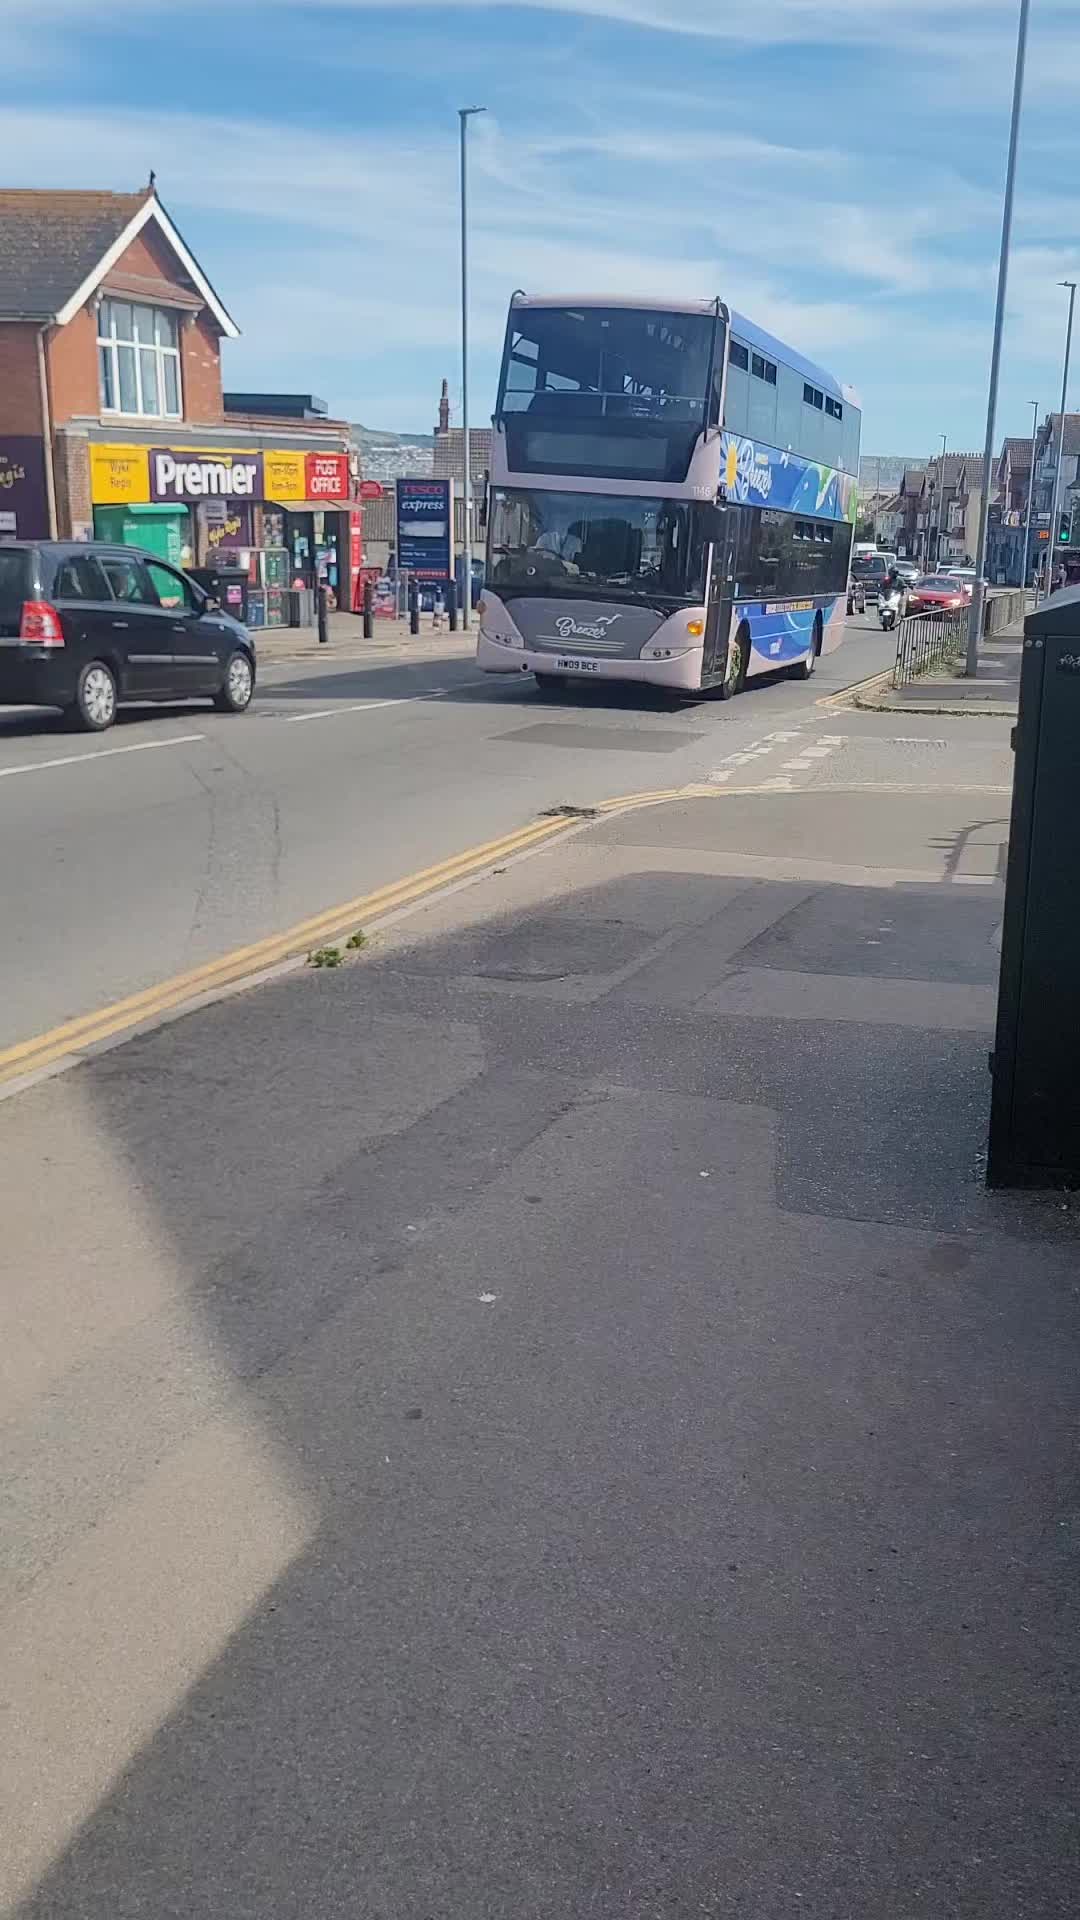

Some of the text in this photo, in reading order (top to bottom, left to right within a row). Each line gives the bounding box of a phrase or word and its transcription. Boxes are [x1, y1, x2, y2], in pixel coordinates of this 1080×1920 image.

[155, 454, 257, 496] Premier
[315, 459, 338, 476] POST
[738, 440, 773, 501] Breezer
[311, 477, 341, 493] OFFICE
[404, 485, 444, 495] TESCO
[401, 499, 445, 513] express
[555, 616, 607, 639] Breezer
[557, 659, 598, 672] HW09 BCE
